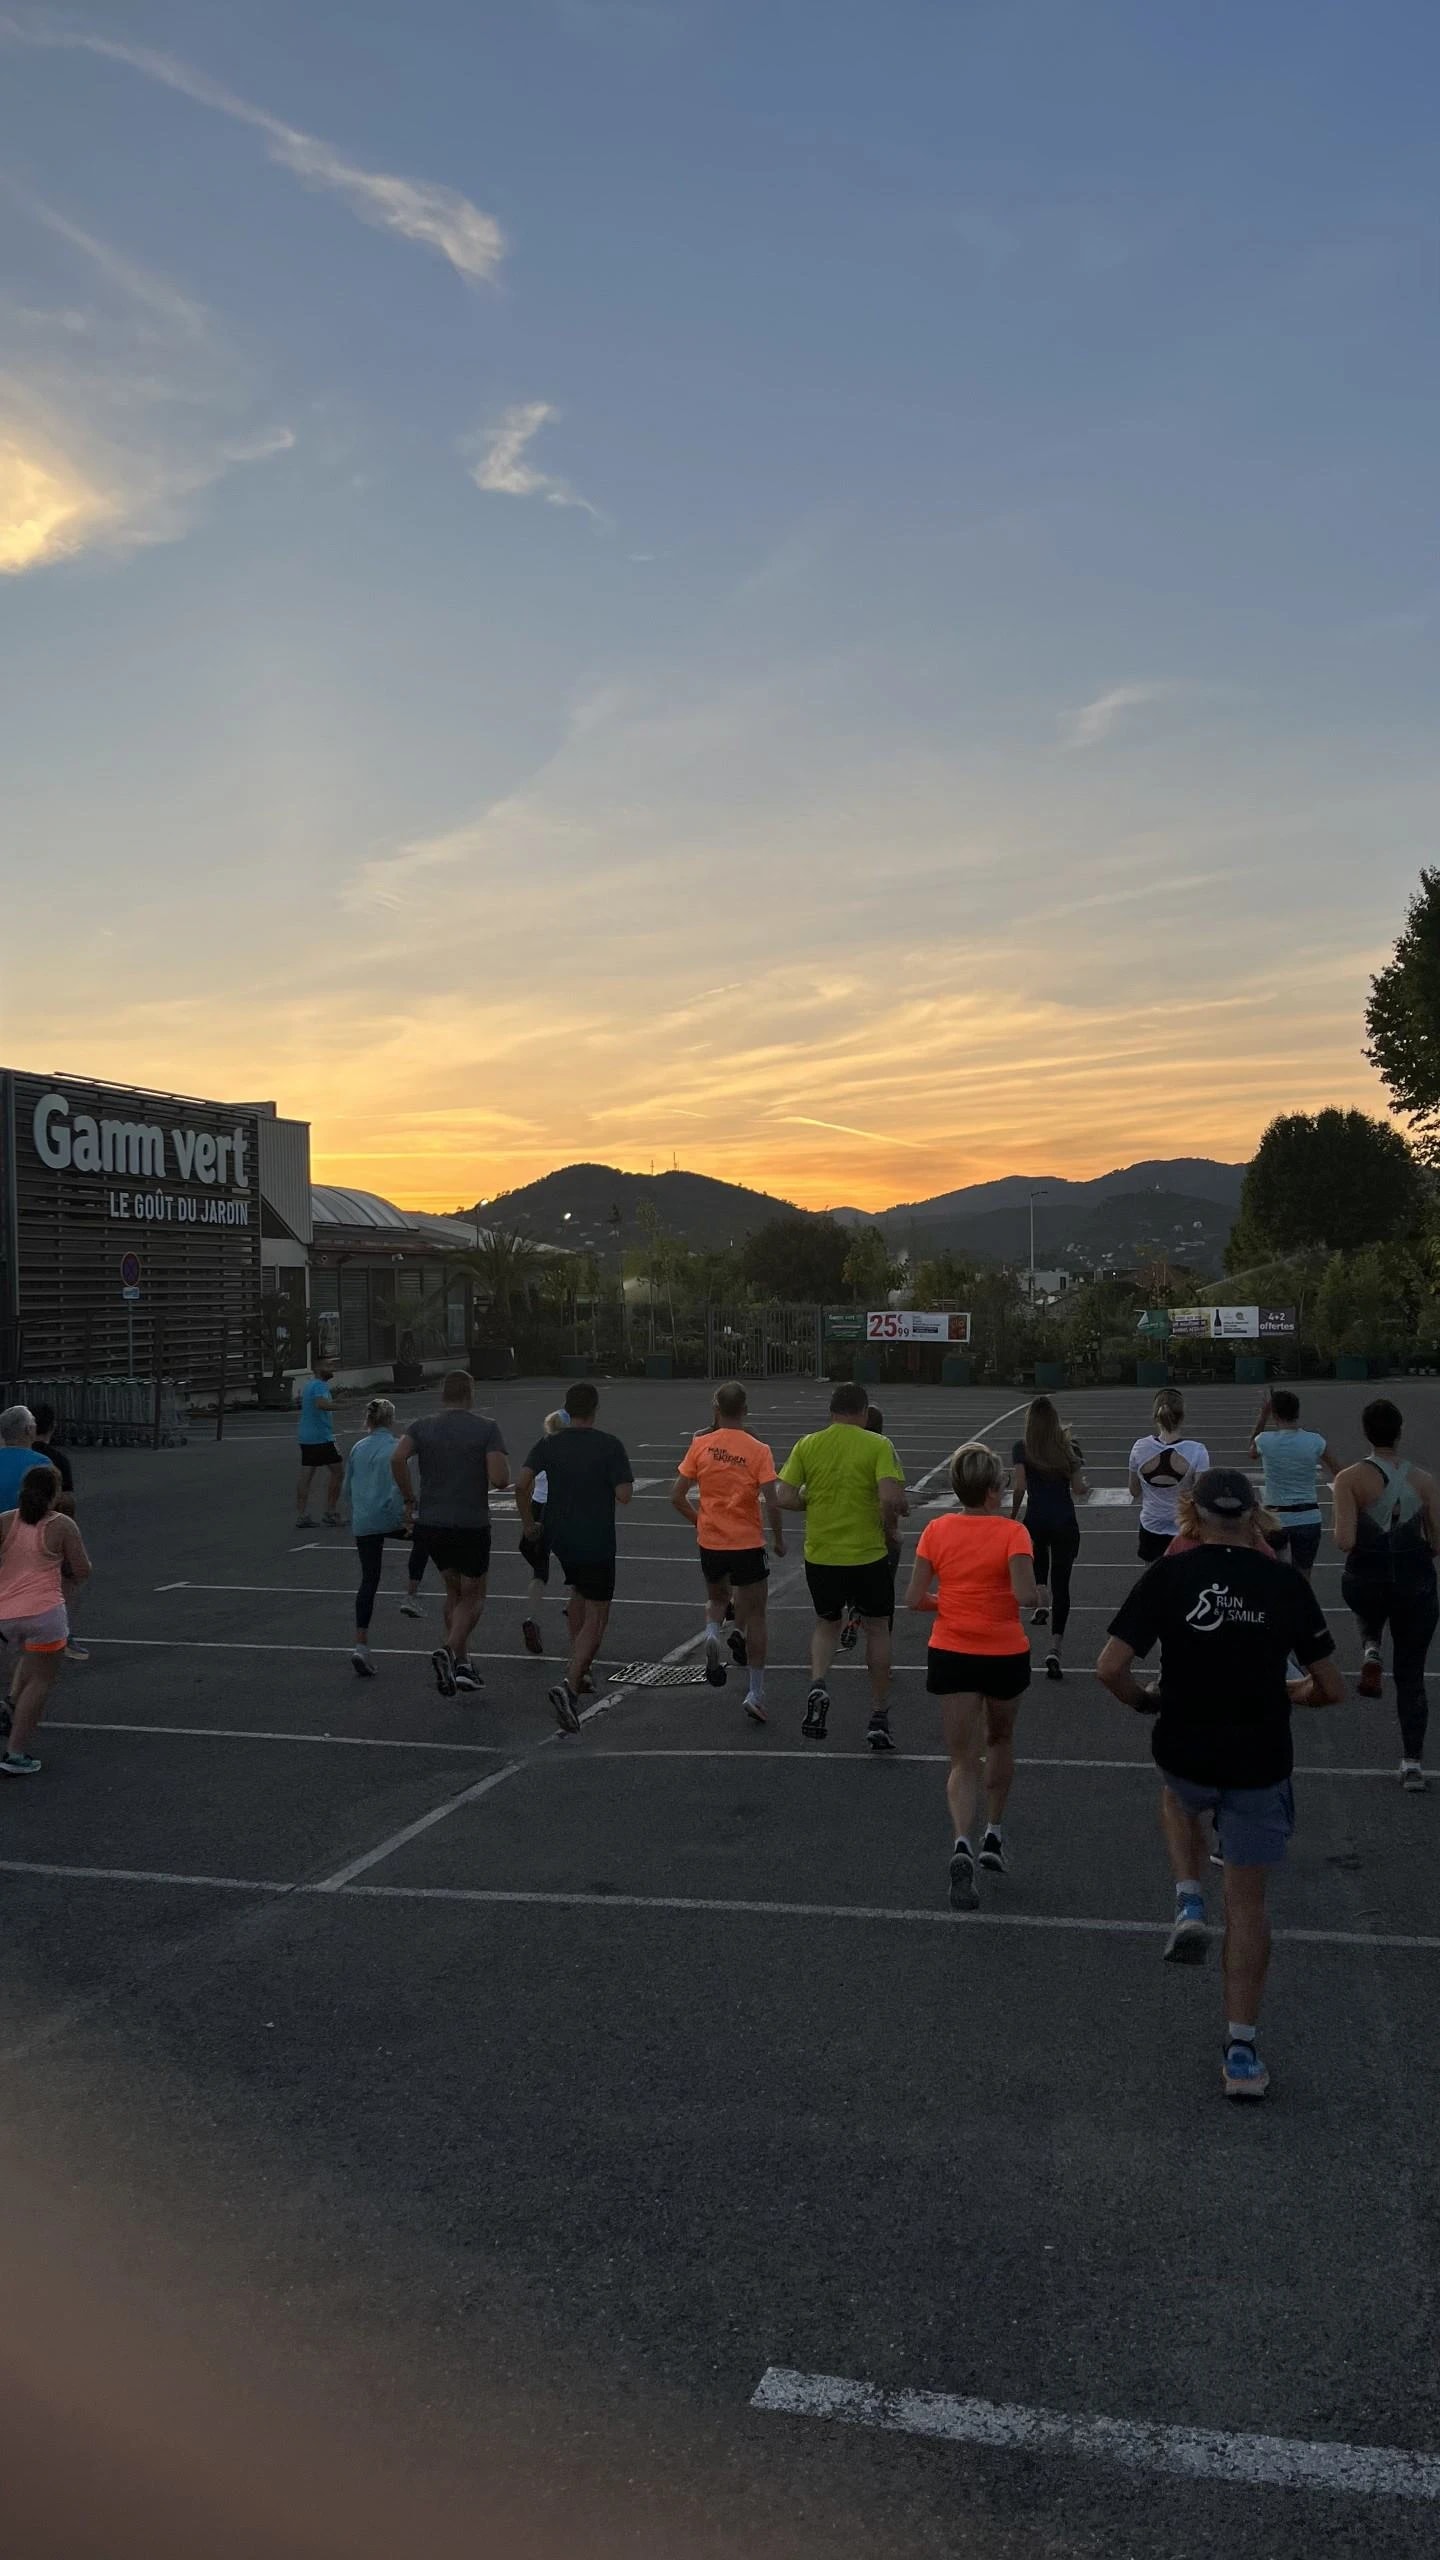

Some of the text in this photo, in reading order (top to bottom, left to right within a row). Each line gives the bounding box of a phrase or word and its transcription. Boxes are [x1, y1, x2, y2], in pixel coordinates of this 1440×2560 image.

[33, 1093, 249, 1188] Gamm vert
[110, 1188, 248, 1226] LE GOÛT DU JARDIN
[1259, 1321, 1294, 1331] offertes
[1216, 1595, 1244, 1608] RUN
[1228, 1609, 1265, 1623] SMILE
